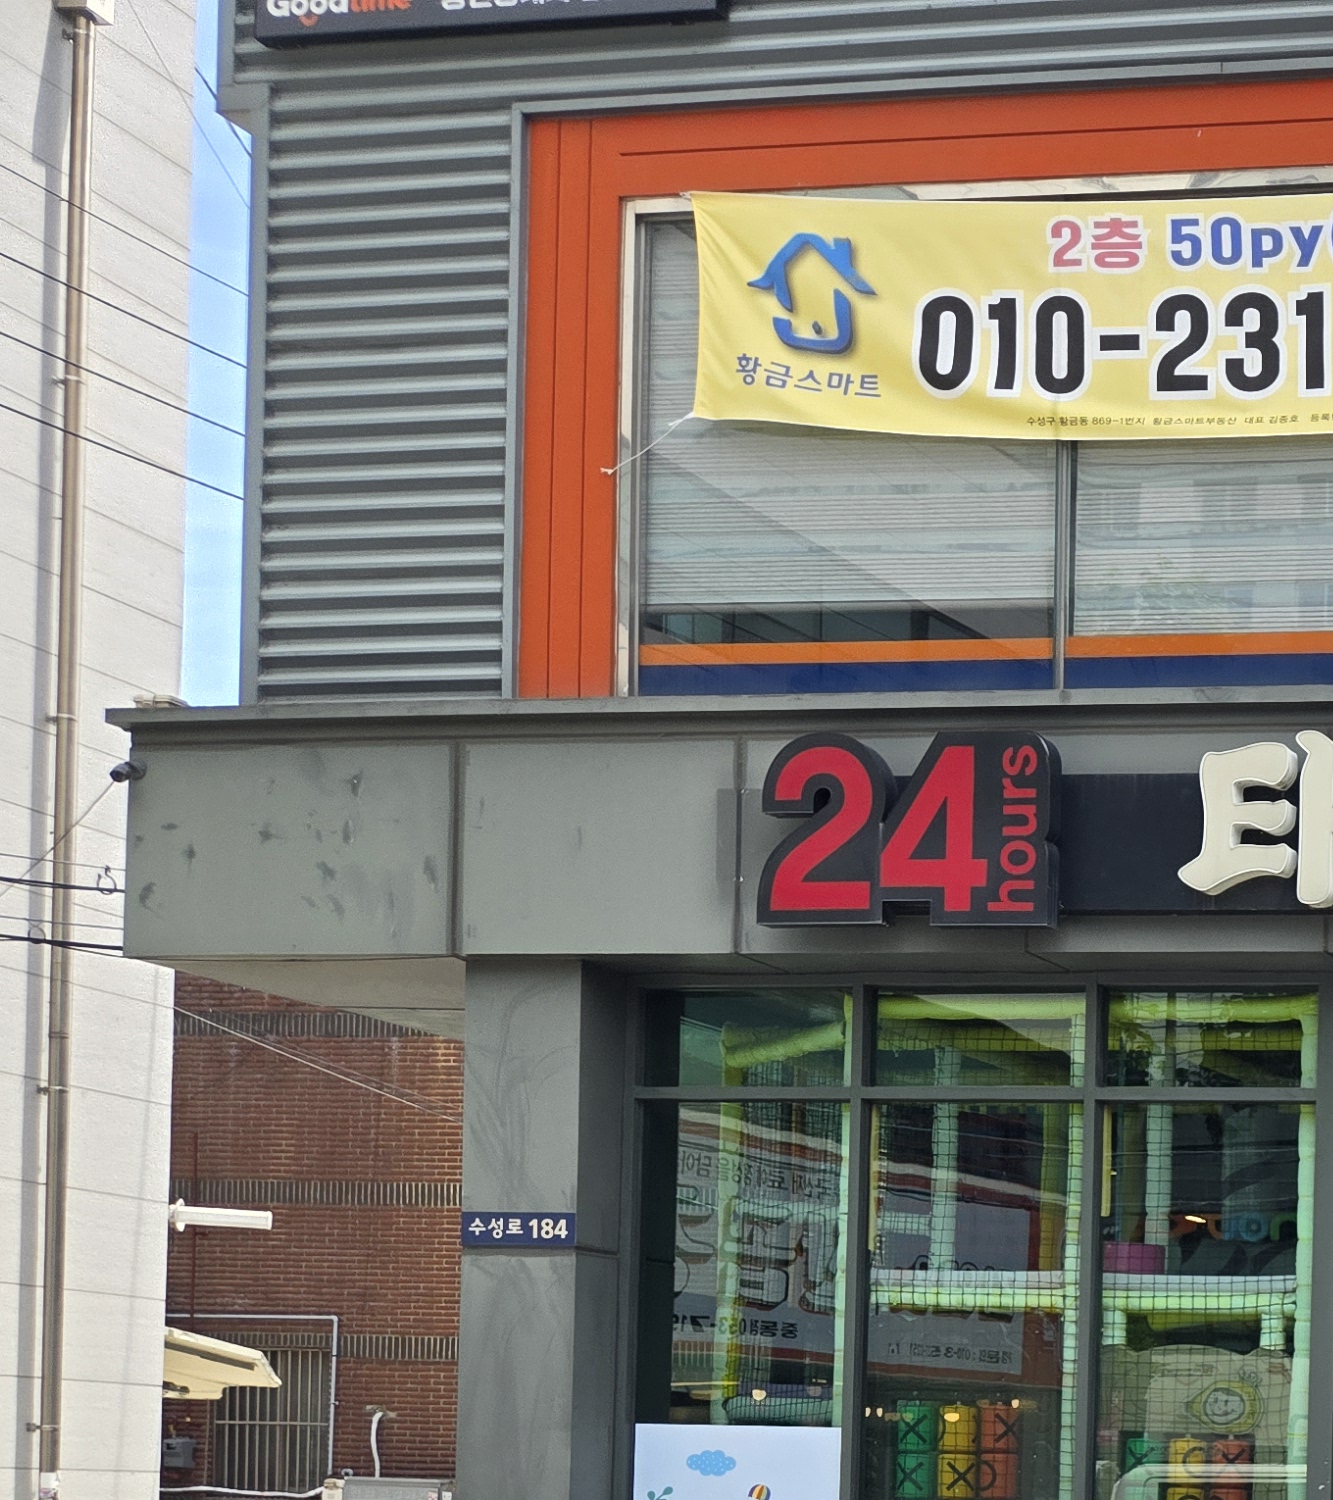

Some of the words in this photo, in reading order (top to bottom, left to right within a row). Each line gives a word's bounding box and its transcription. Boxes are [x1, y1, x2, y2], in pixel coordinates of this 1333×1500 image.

[1049, 217, 1145, 269] 2층
[735, 352, 882, 398] 황금스마트
[1026, 416, 1056, 426] 수성구
[1092, 416, 1146, 426] 869-1번지
[769, 745, 989, 912] 24
[987, 744, 1038, 912] hours
[468, 1218, 524, 1239] 수성로
[528, 1218, 569, 1239] 184
